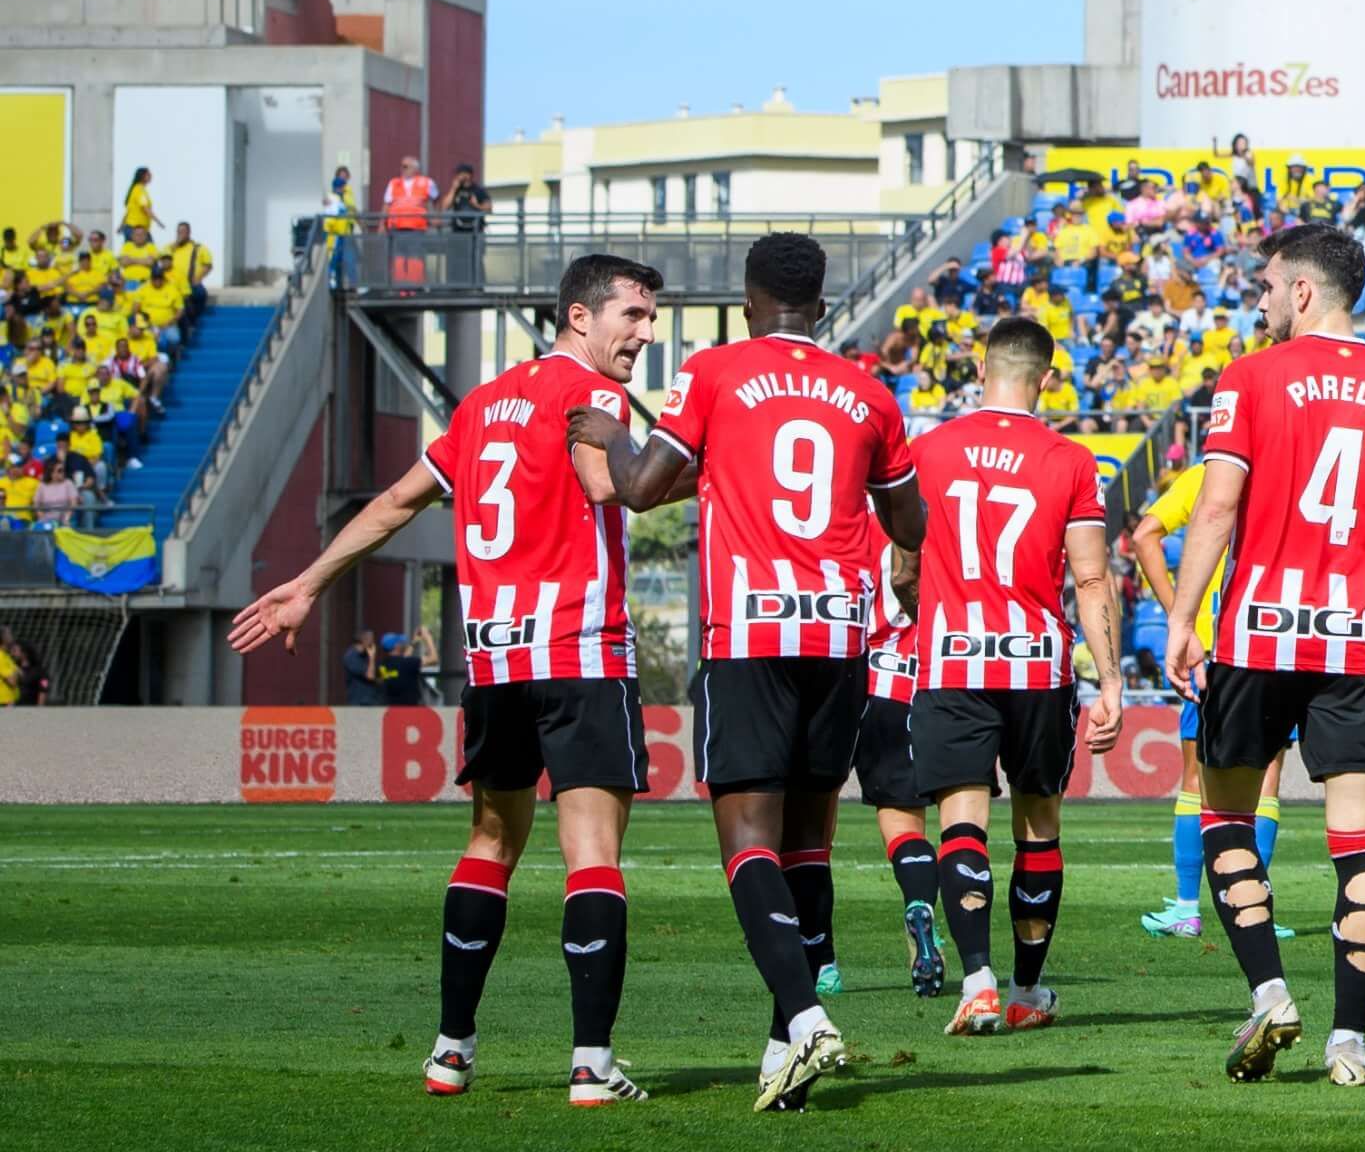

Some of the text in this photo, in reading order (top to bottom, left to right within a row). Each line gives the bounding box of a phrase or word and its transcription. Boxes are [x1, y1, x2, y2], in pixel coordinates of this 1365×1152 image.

[735, 372, 870, 425] WILLIAMS
[771, 418, 835, 540] 9
[963, 446, 1025, 475] YURI
[465, 441, 518, 562] 3
[1298, 426, 1364, 547] 4
[945, 479, 1038, 587] 17
[745, 591, 868, 626] DIGI
[941, 633, 1053, 659] DIGI
[240, 727, 337, 750] BURGER
[240, 751, 337, 784] KING
